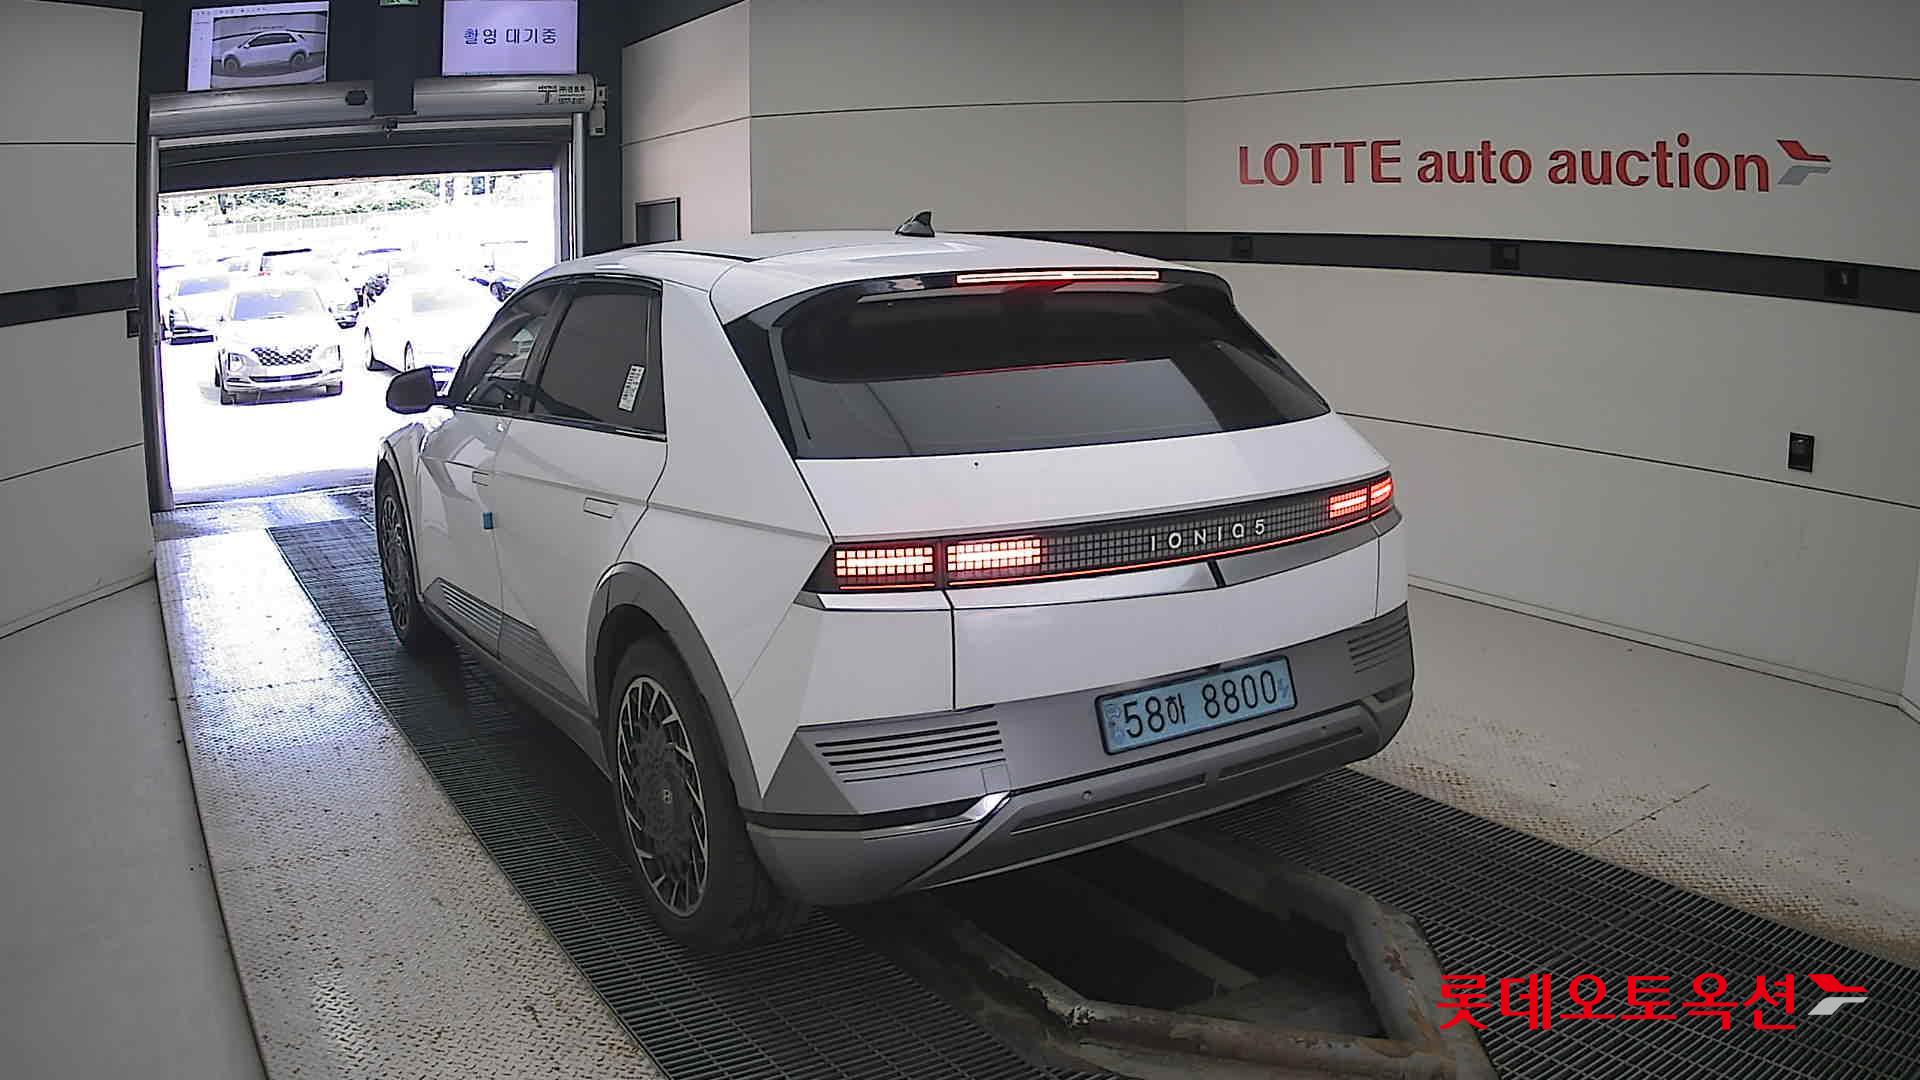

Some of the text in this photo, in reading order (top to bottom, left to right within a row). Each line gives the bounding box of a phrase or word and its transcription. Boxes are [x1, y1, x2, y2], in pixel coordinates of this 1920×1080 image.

[505, 28, 557, 45] 대기중
[1239, 133, 1769, 192] LOTTE auto auction
[1123, 670, 1277, 738] 58하 8800
